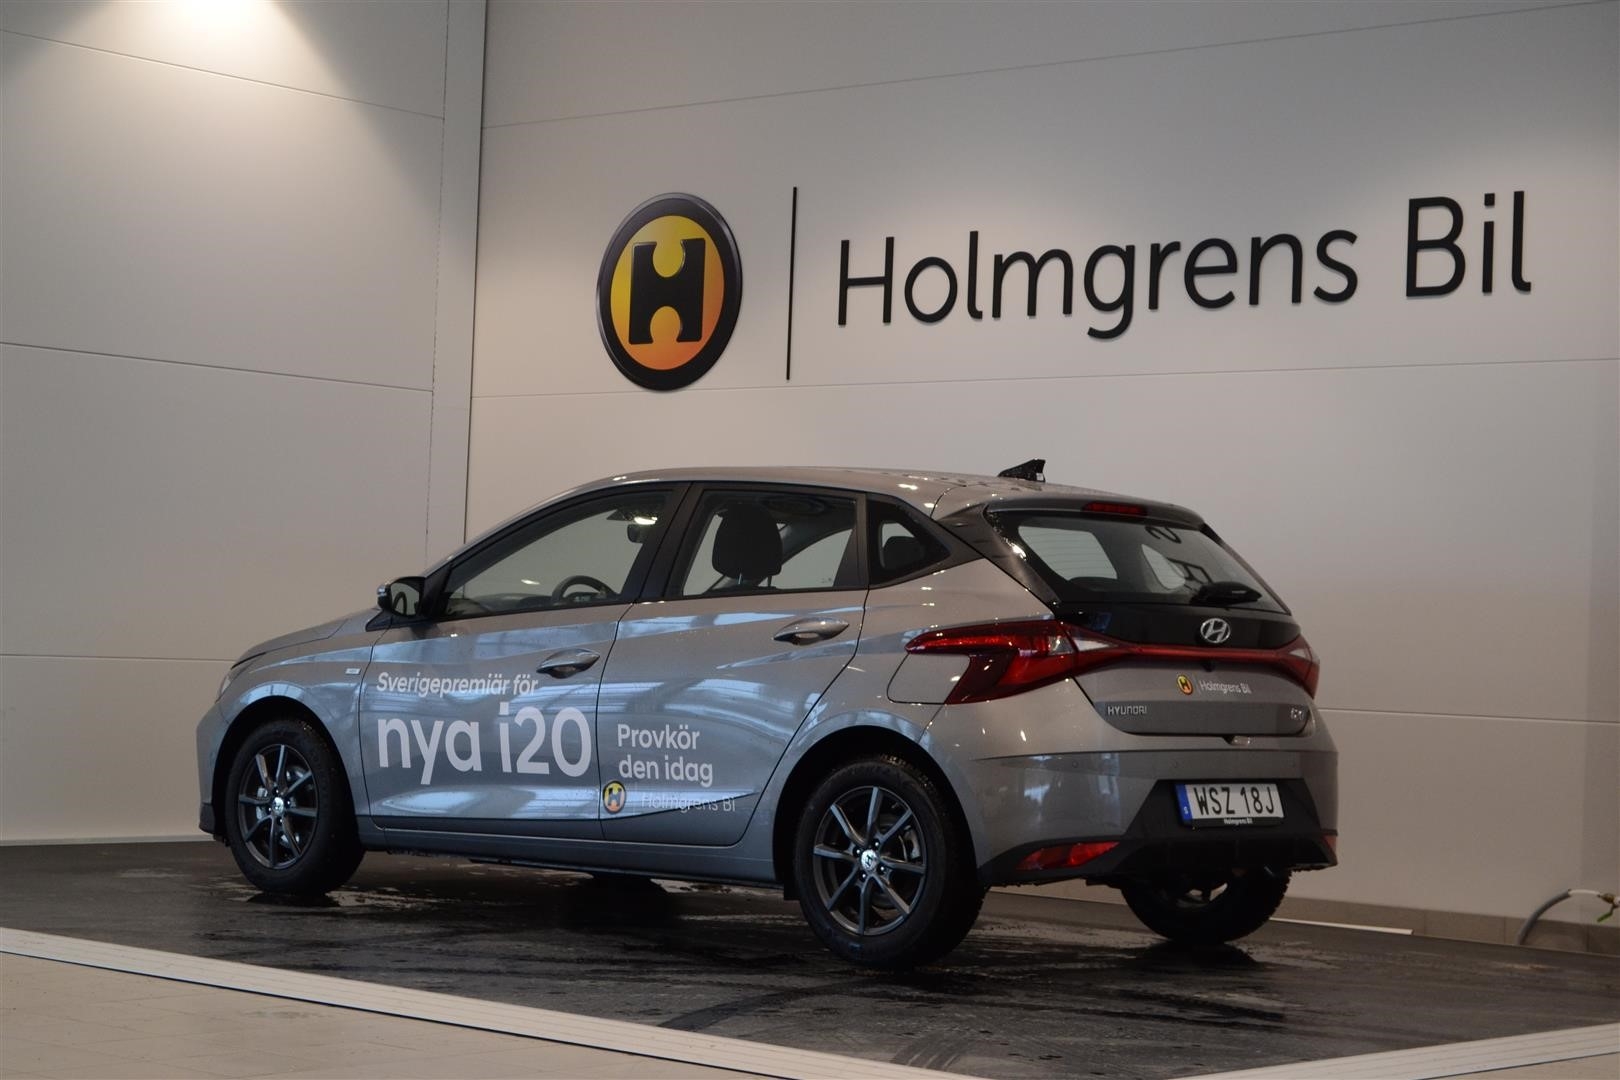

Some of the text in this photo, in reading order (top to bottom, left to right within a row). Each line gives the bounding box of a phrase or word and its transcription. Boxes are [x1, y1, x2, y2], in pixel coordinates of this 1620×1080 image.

[837, 190, 1533, 341] Holmgrens Bil
[376, 671, 539, 698] Sverigepremiär för
[1199, 680, 1252, 695] Holmgrens Bil
[1107, 705, 1147, 716] HYUNDAI
[377, 702, 593, 786] nya i20
[617, 723, 701, 751] Provkör
[618, 755, 714, 788] den idag
[1193, 786, 1275, 816] WSZ 18J
